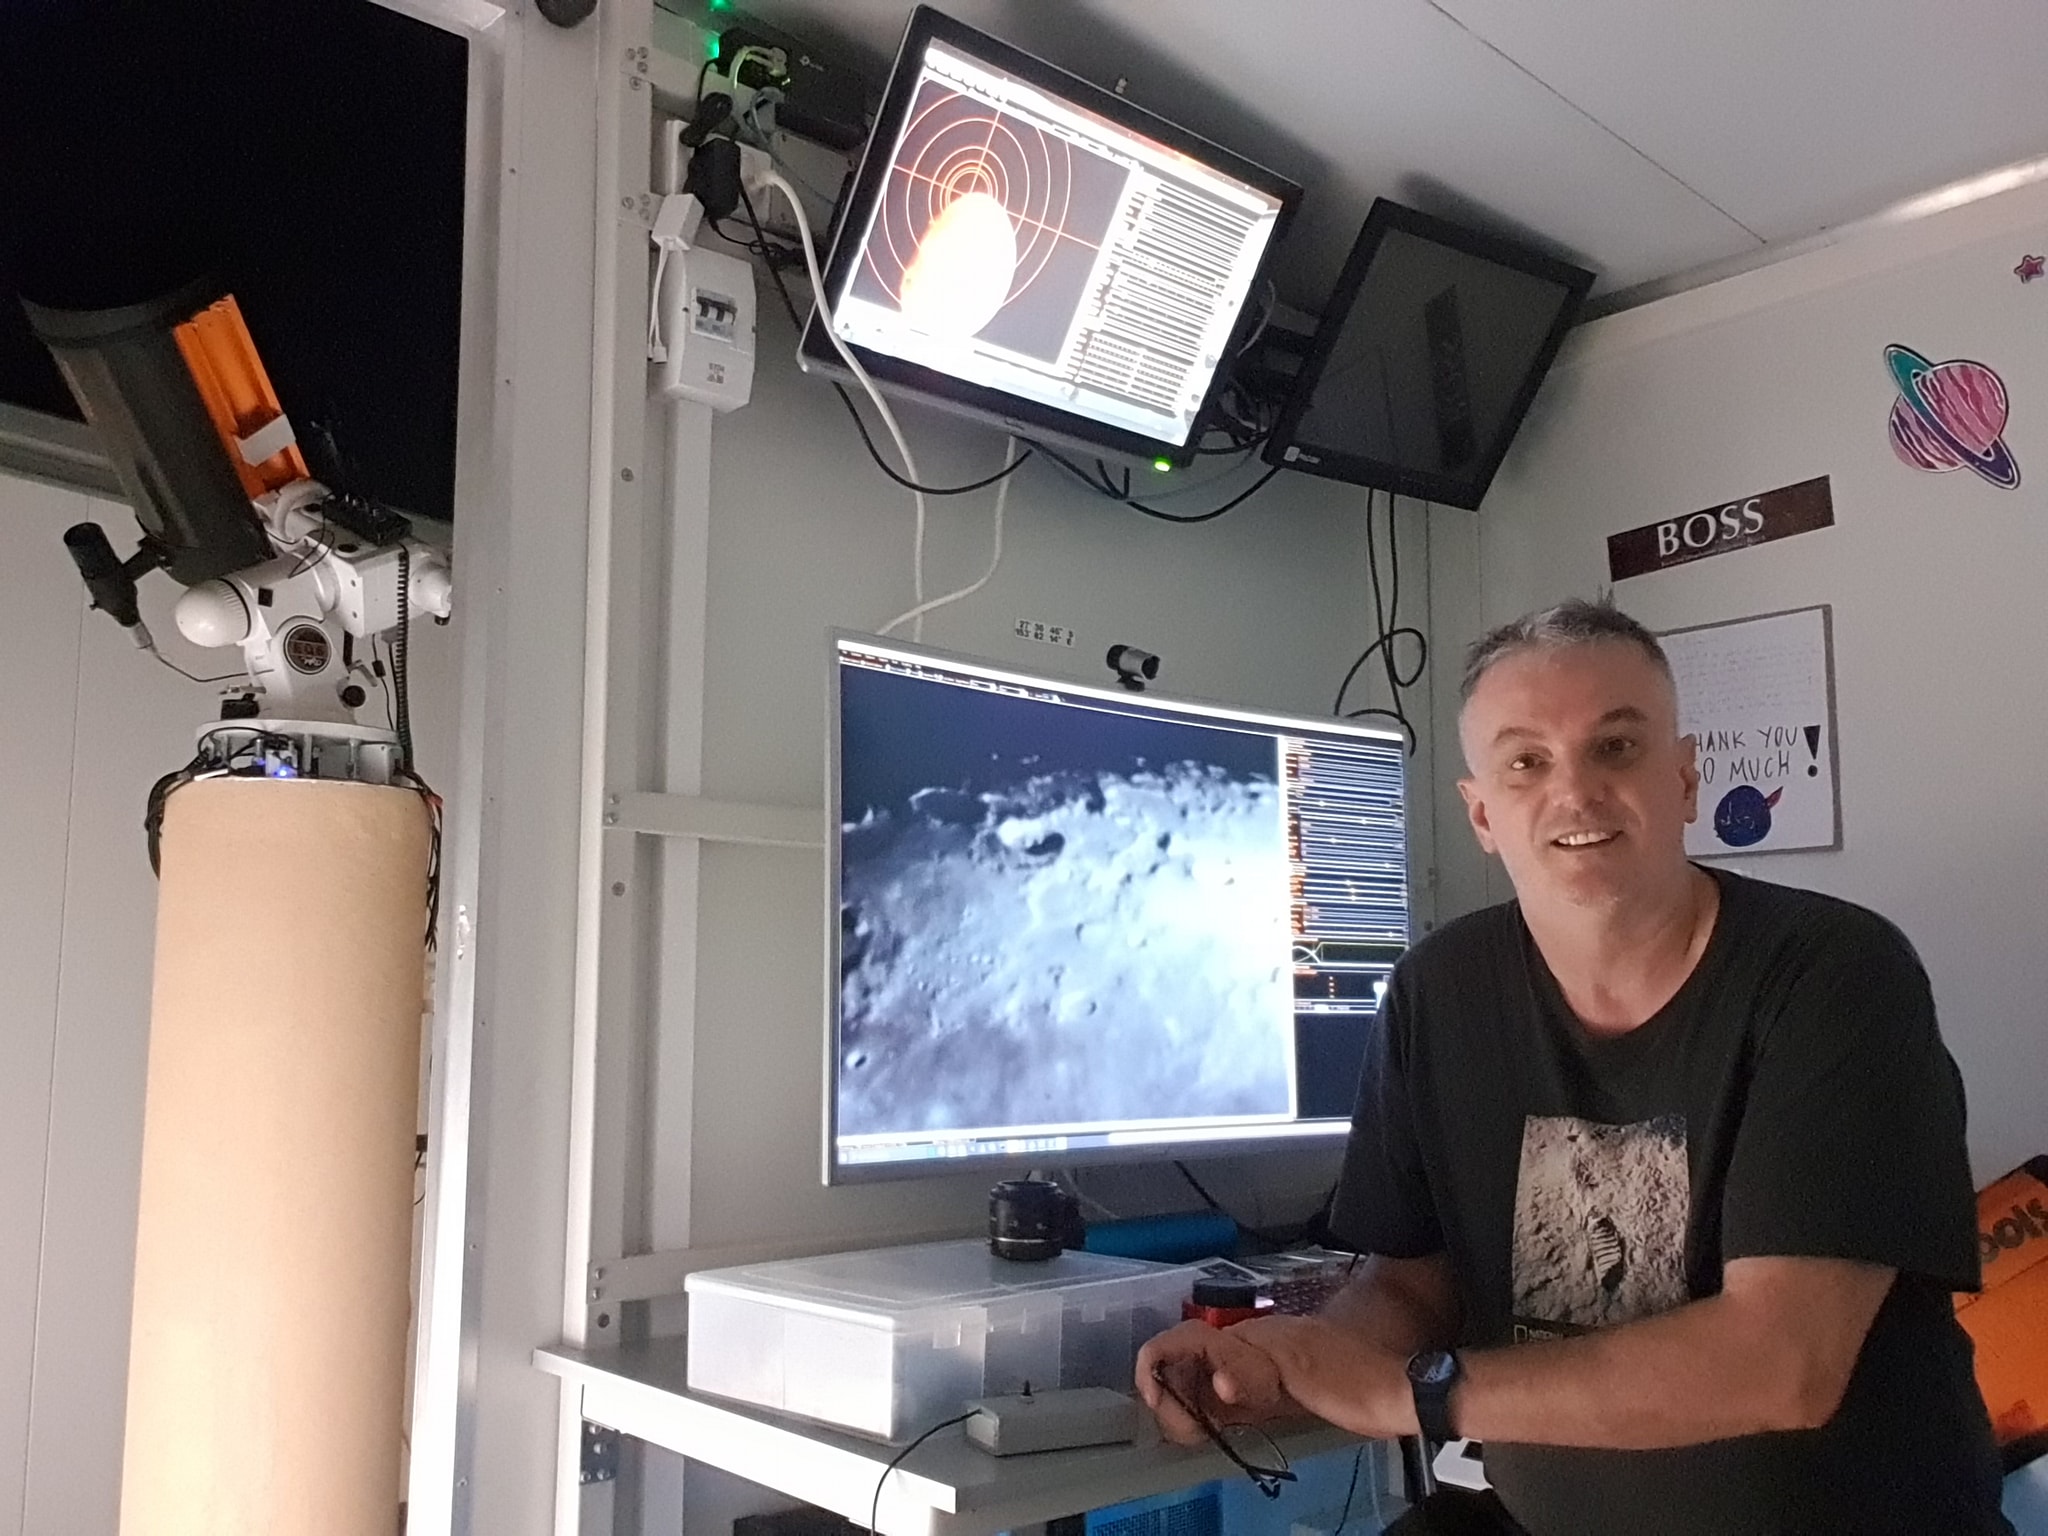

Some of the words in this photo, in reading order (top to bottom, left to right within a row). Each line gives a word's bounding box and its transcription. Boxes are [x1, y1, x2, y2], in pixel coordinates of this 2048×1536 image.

[1656, 498, 1765, 558] BOSS
[1695, 730, 1746, 752] HANK
[1758, 726, 1798, 748] YOU
[1696, 757, 1715, 784] O
[1729, 750, 1790, 782] MUCH
